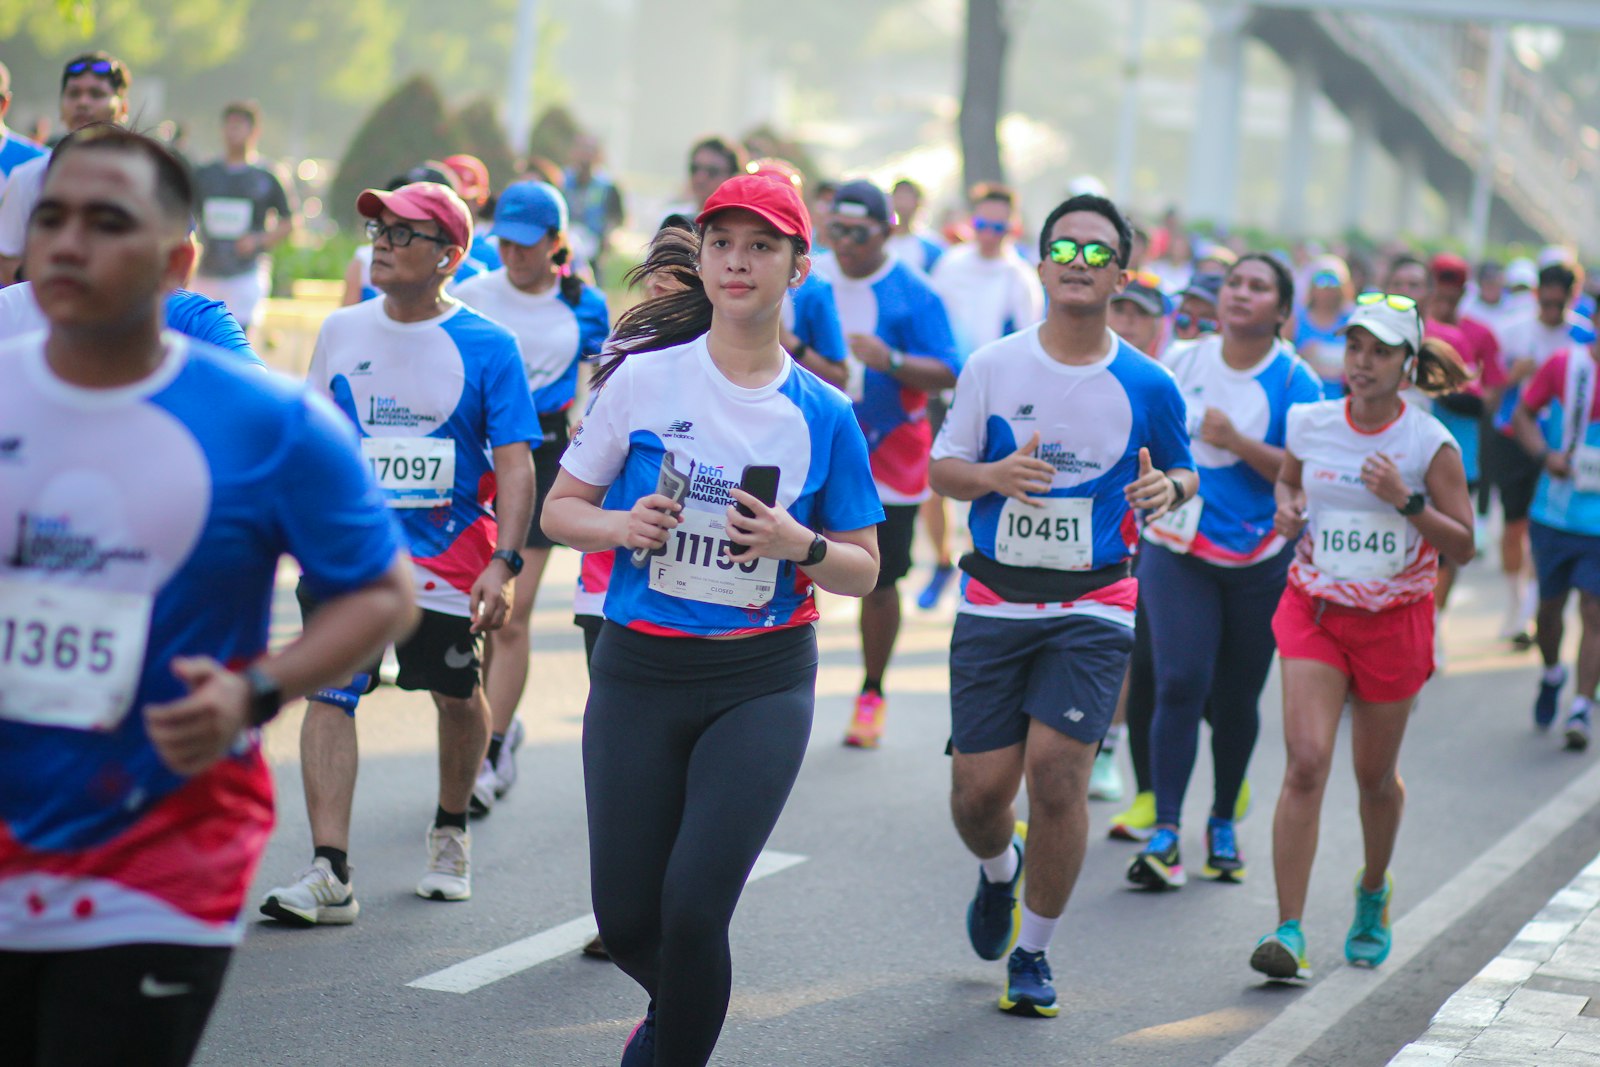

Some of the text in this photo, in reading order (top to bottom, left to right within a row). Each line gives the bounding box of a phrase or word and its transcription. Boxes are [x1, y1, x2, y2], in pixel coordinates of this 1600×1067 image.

[377, 395, 396, 406] btn
[376, 414, 437, 422] INTERNATIONAL
[673, 433, 695, 441] balance
[1042, 440, 1062, 452] btn
[698, 462, 724, 478] btn
[693, 475, 740, 489] JAKARTA
[692, 483, 733, 499] INTERN
[691, 492, 738, 508] MARATHO
[1008, 512, 1079, 542] 10451
[1322, 529, 1397, 554] 16646
[658, 568, 666, 580] F
[710, 586, 734, 595] CLOSED
[316, 690, 347, 702] ELLER
